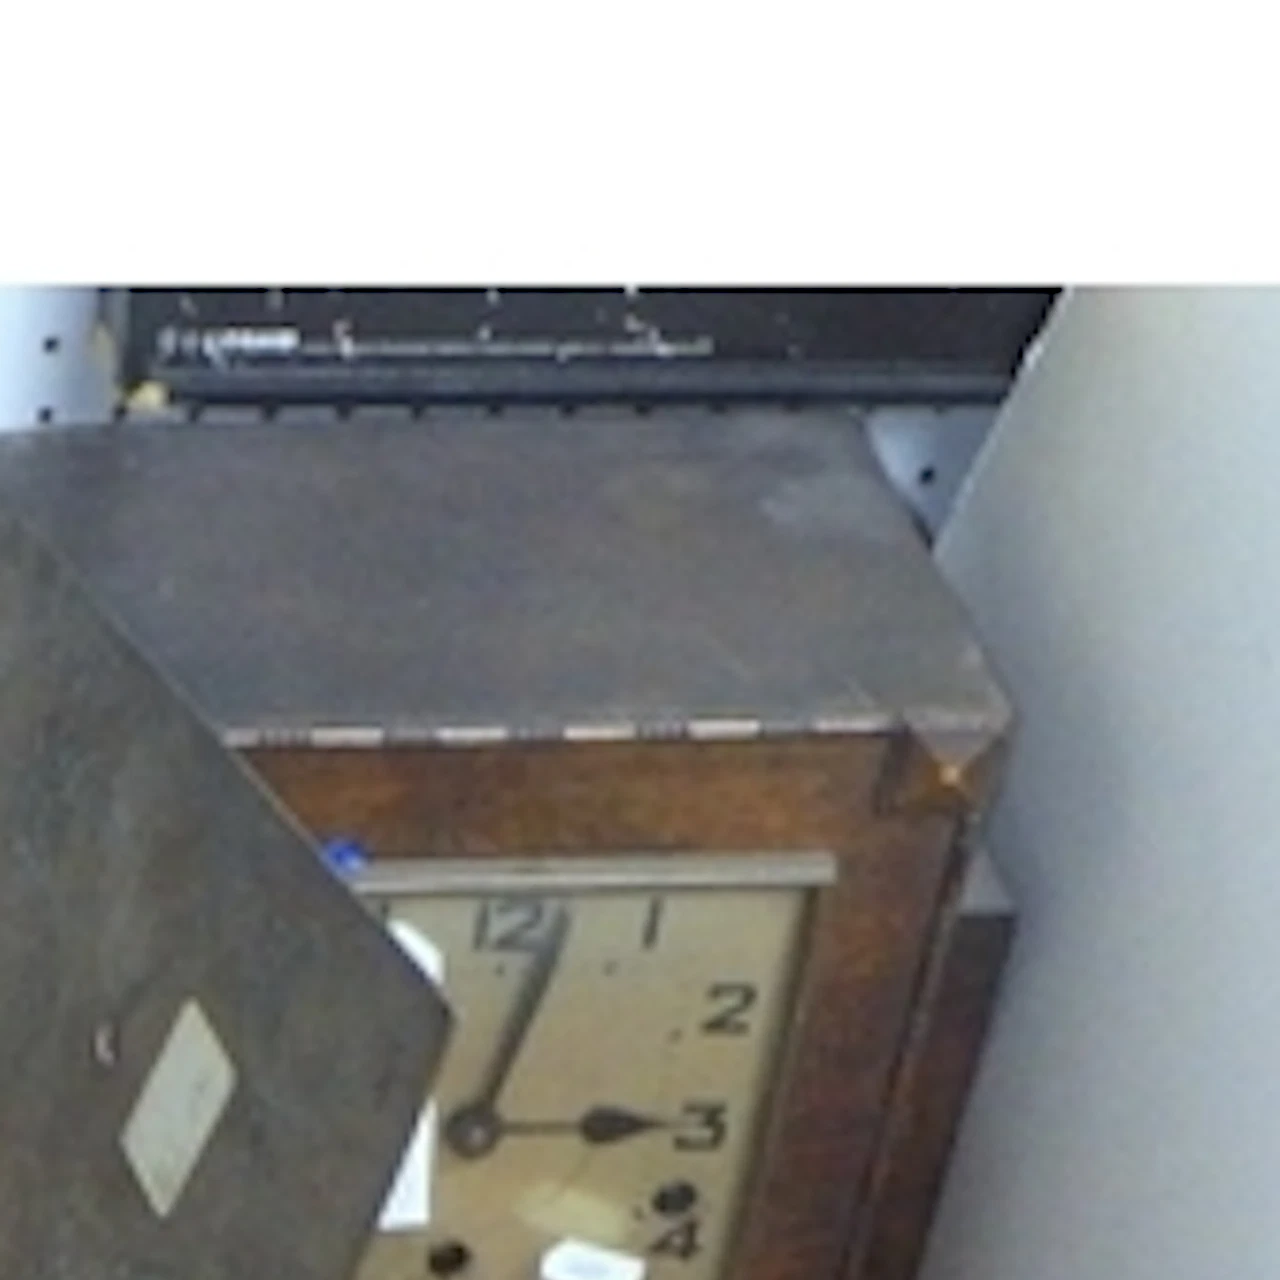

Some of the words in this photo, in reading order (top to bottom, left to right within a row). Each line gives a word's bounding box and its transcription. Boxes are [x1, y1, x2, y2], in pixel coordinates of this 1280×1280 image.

[473, 900, 546, 952] 12
[641, 898, 665, 950] 1
[701, 980, 759, 1036] 2
[672, 1103, 728, 1154] 3
[651, 1220, 703, 1261] 4
